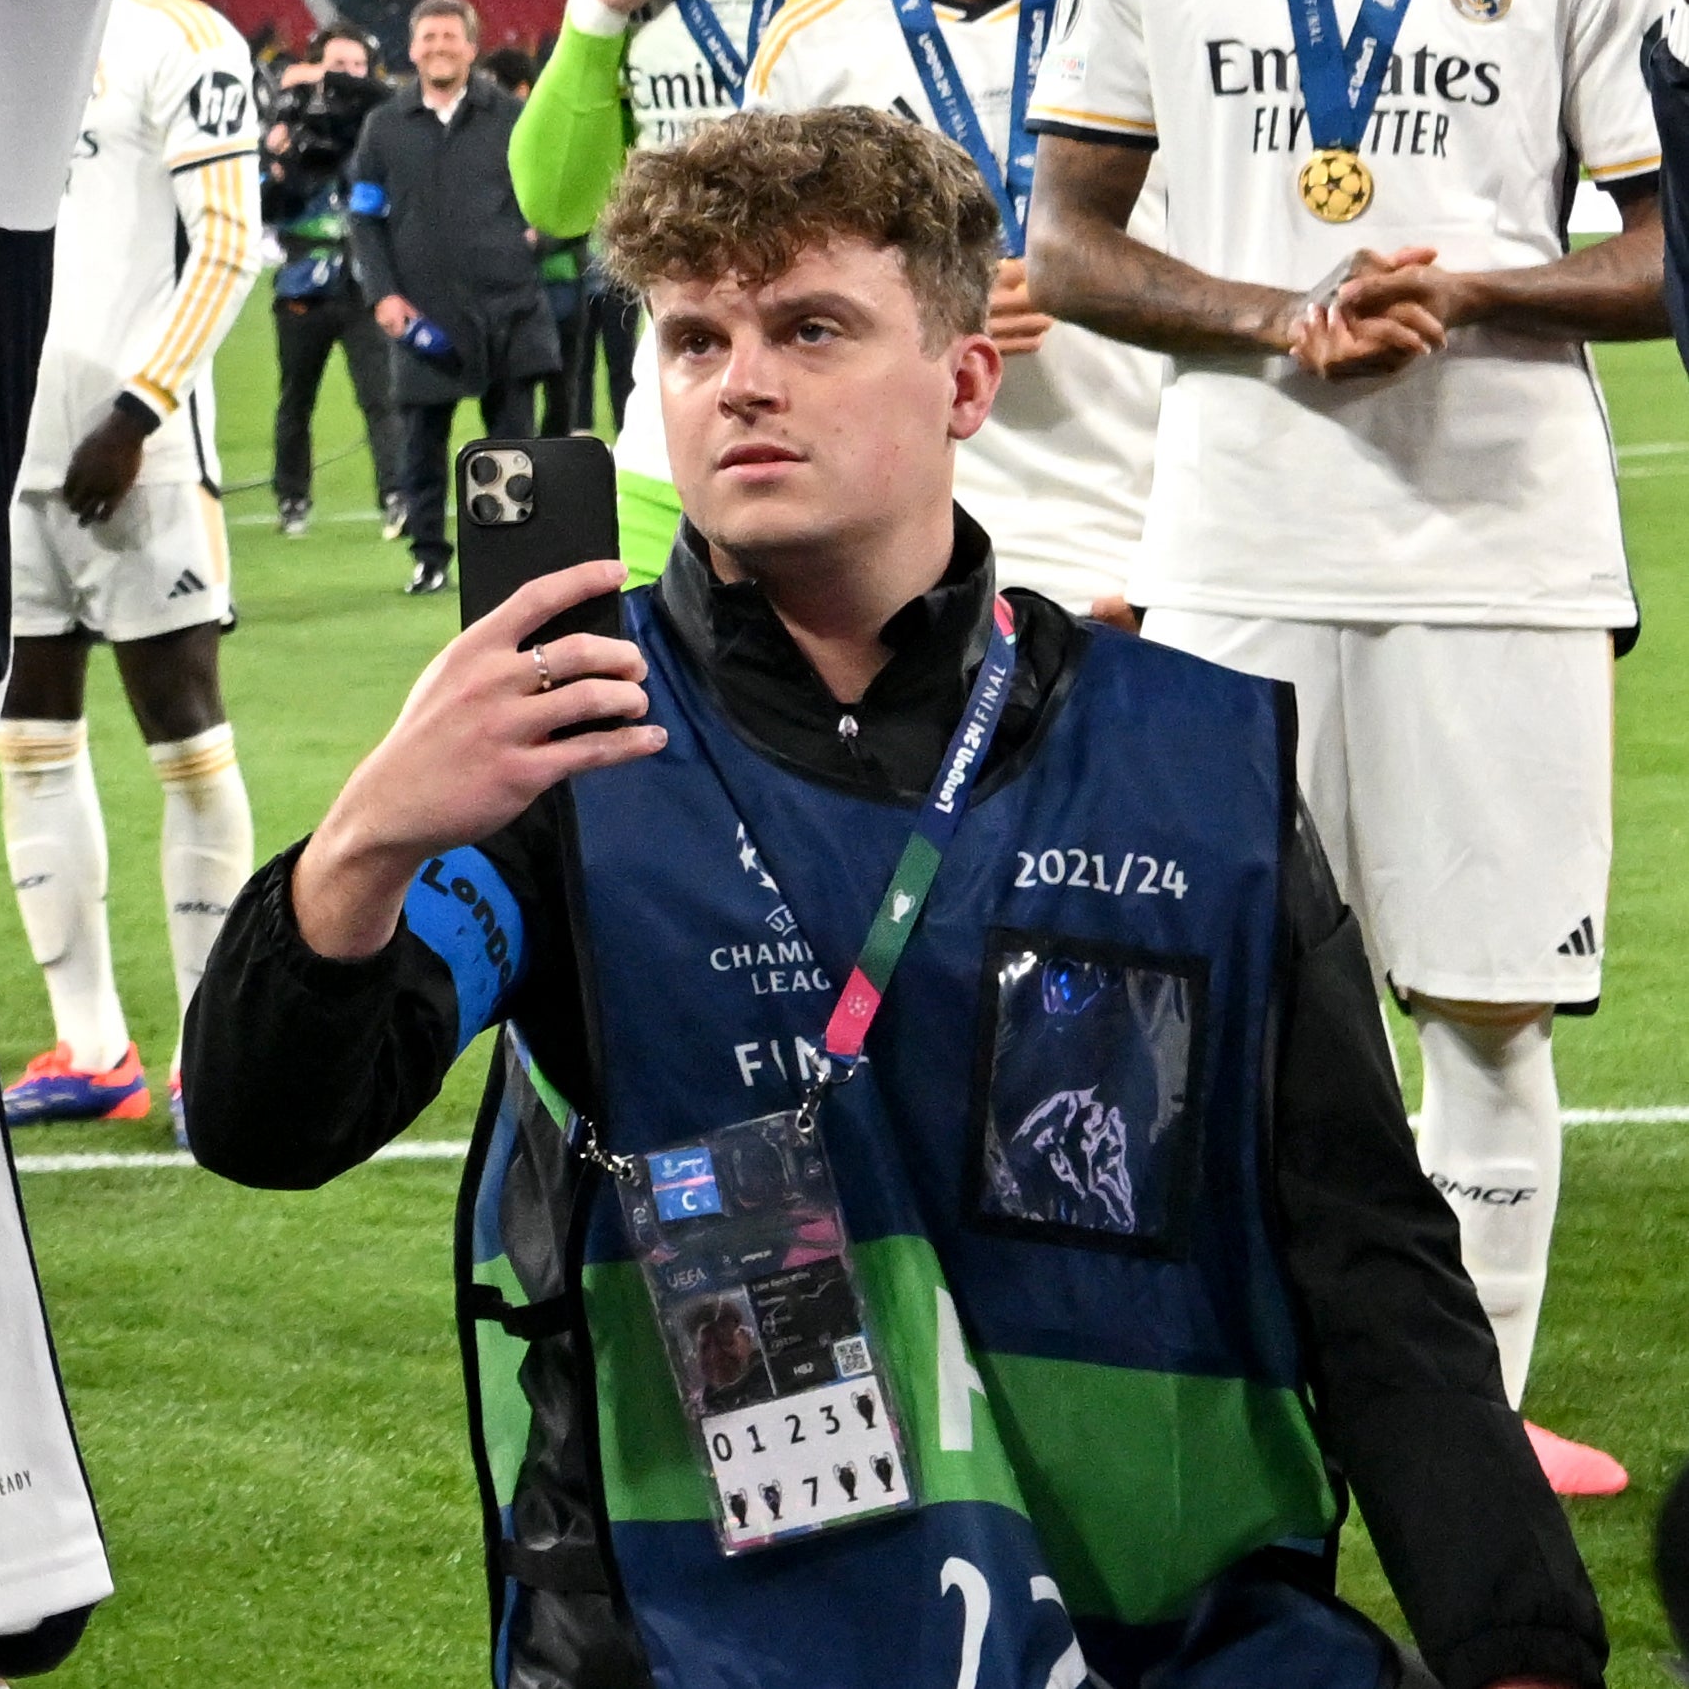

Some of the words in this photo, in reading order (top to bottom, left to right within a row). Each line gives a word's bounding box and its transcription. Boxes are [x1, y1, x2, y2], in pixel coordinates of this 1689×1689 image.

[1204, 38, 1501, 107] Emates
[962, 720, 986, 752] 24
[974, 663, 1007, 724] FINAL
[1014, 848, 1189, 900] 2021/24
[709, 939, 814, 971] CHAM
[681, 1191, 698, 1212] C
[712, 1432, 733, 1462] 0
[746, 1424, 766, 1454] 1
[784, 1414, 806, 1444] 2
[819, 1404, 841, 1435] 3
[802, 1476, 819, 1507] 7
